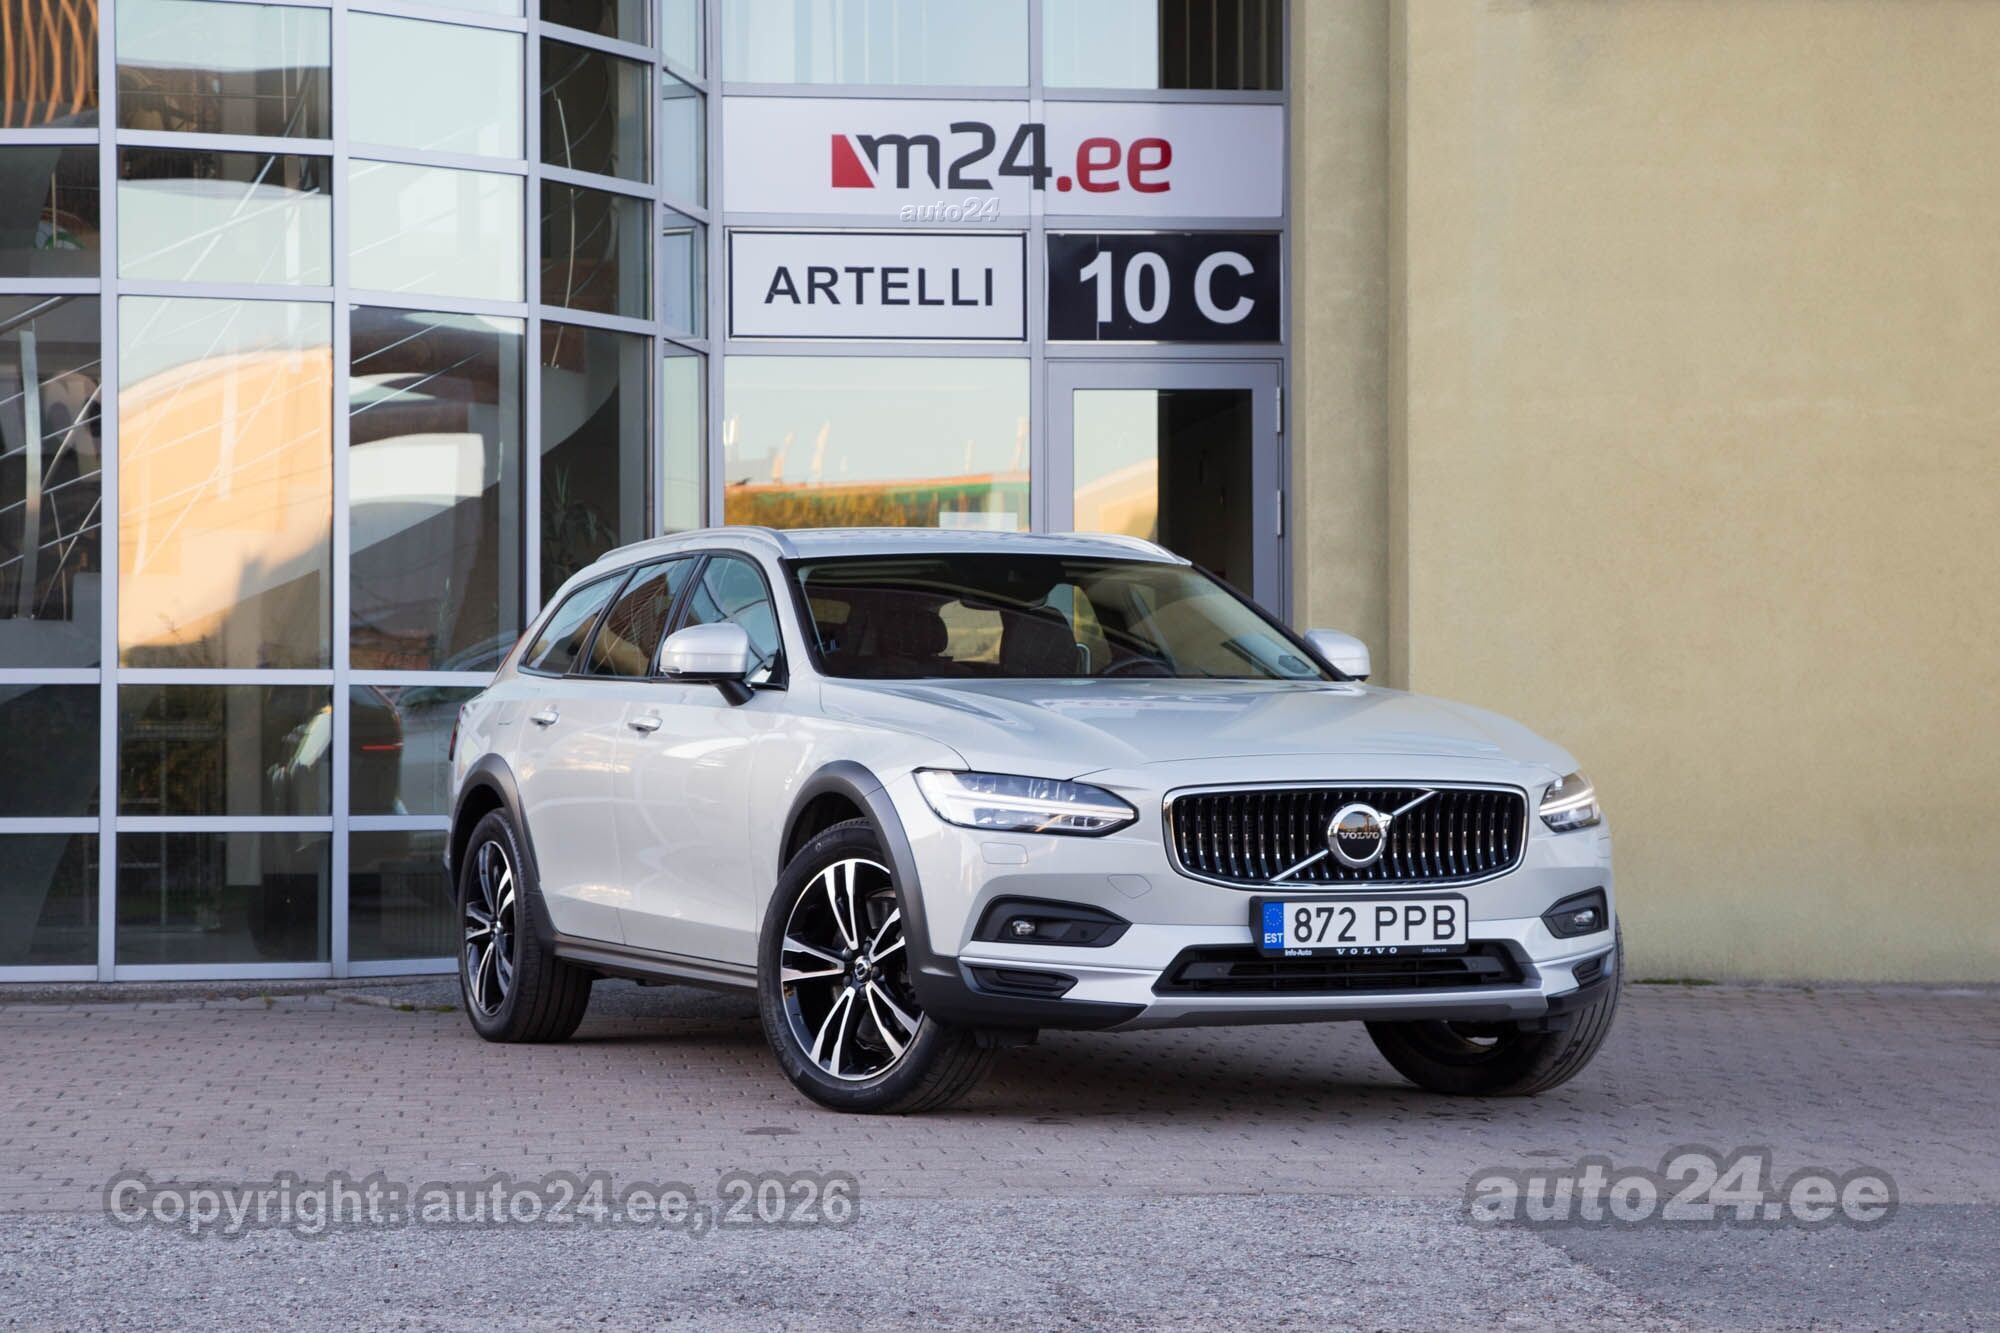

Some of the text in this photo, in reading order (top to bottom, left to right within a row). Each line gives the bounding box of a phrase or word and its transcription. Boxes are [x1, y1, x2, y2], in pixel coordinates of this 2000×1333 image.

[853, 121, 1173, 194] m24.ee
[764, 266, 993, 306] ARTELLI
[1079, 250, 1256, 325] 10 C
[1339, 831, 1380, 840] VOLVO
[1264, 933, 1284, 944] EST
[1294, 905, 1456, 943] 872 PPB
[1336, 947, 1397, 955] VOLVO
